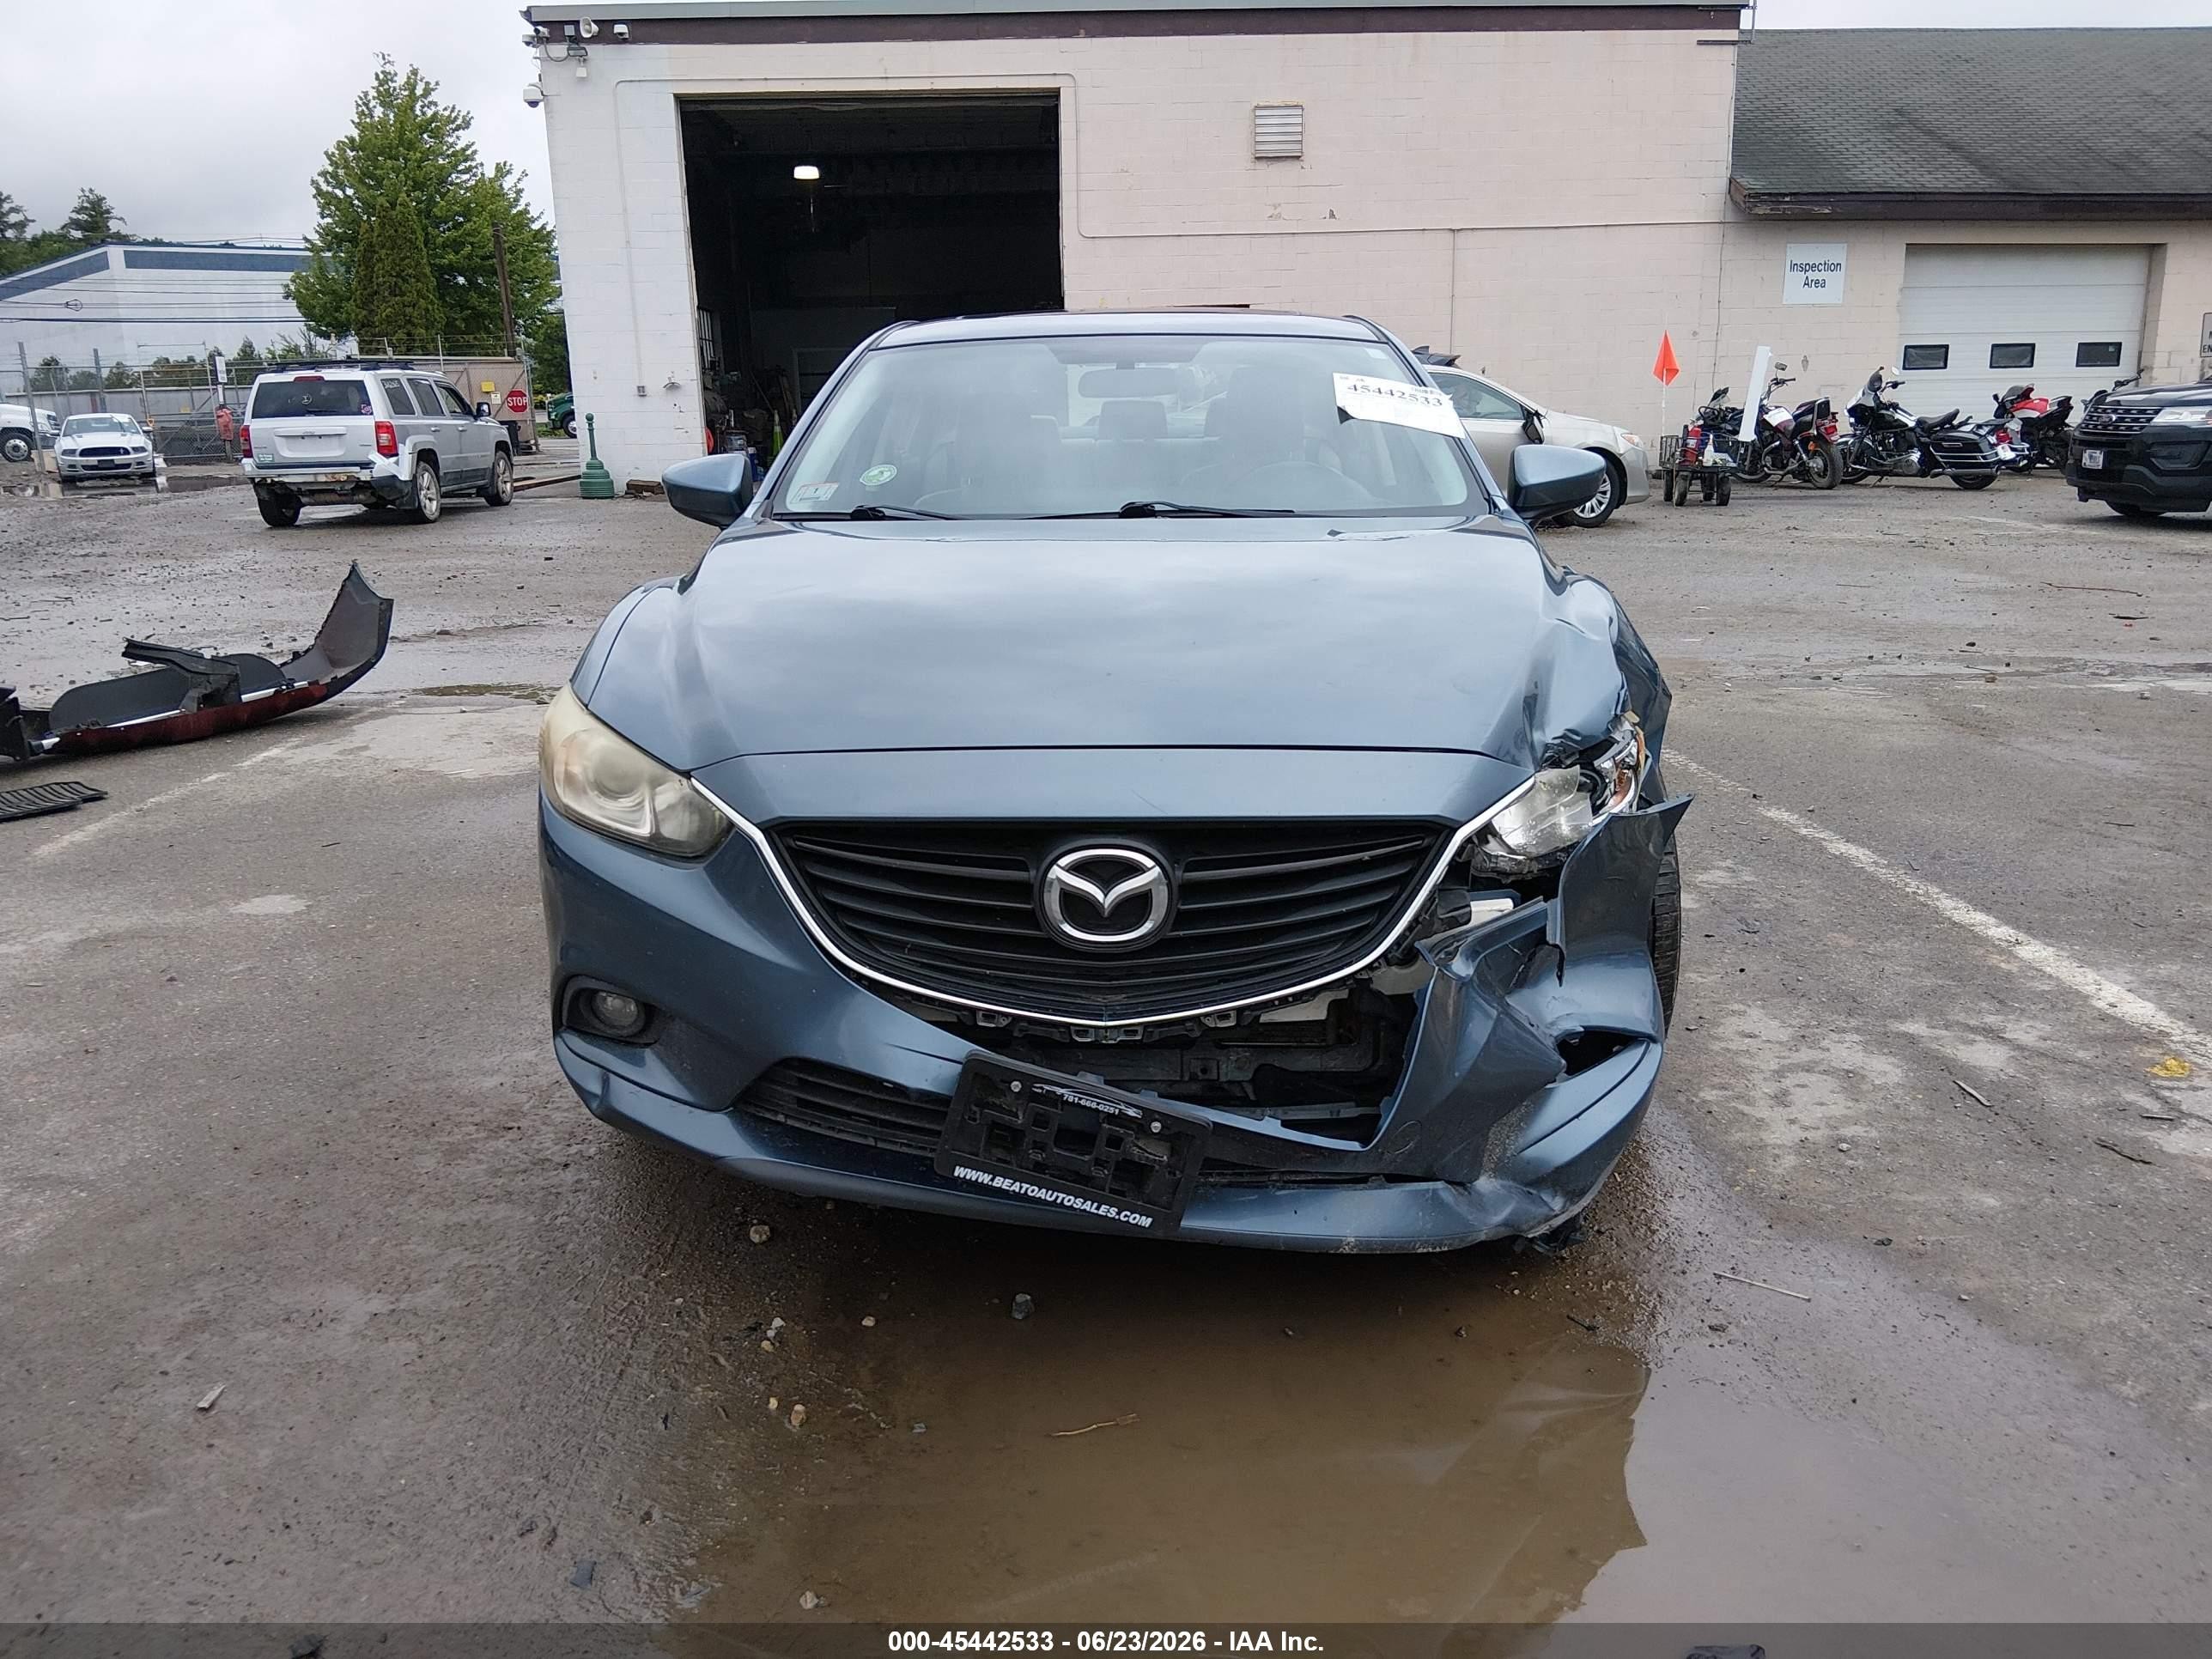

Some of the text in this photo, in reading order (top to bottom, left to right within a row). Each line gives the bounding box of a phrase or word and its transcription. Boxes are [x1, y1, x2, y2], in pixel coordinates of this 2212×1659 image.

[1790, 259, 1842, 275] Inspection
[1802, 276, 1826, 289] Area
[1347, 384, 1443, 407] 45442533
[953, 1165, 1153, 1228] WWW.BEATOAUTOSALES.COM
